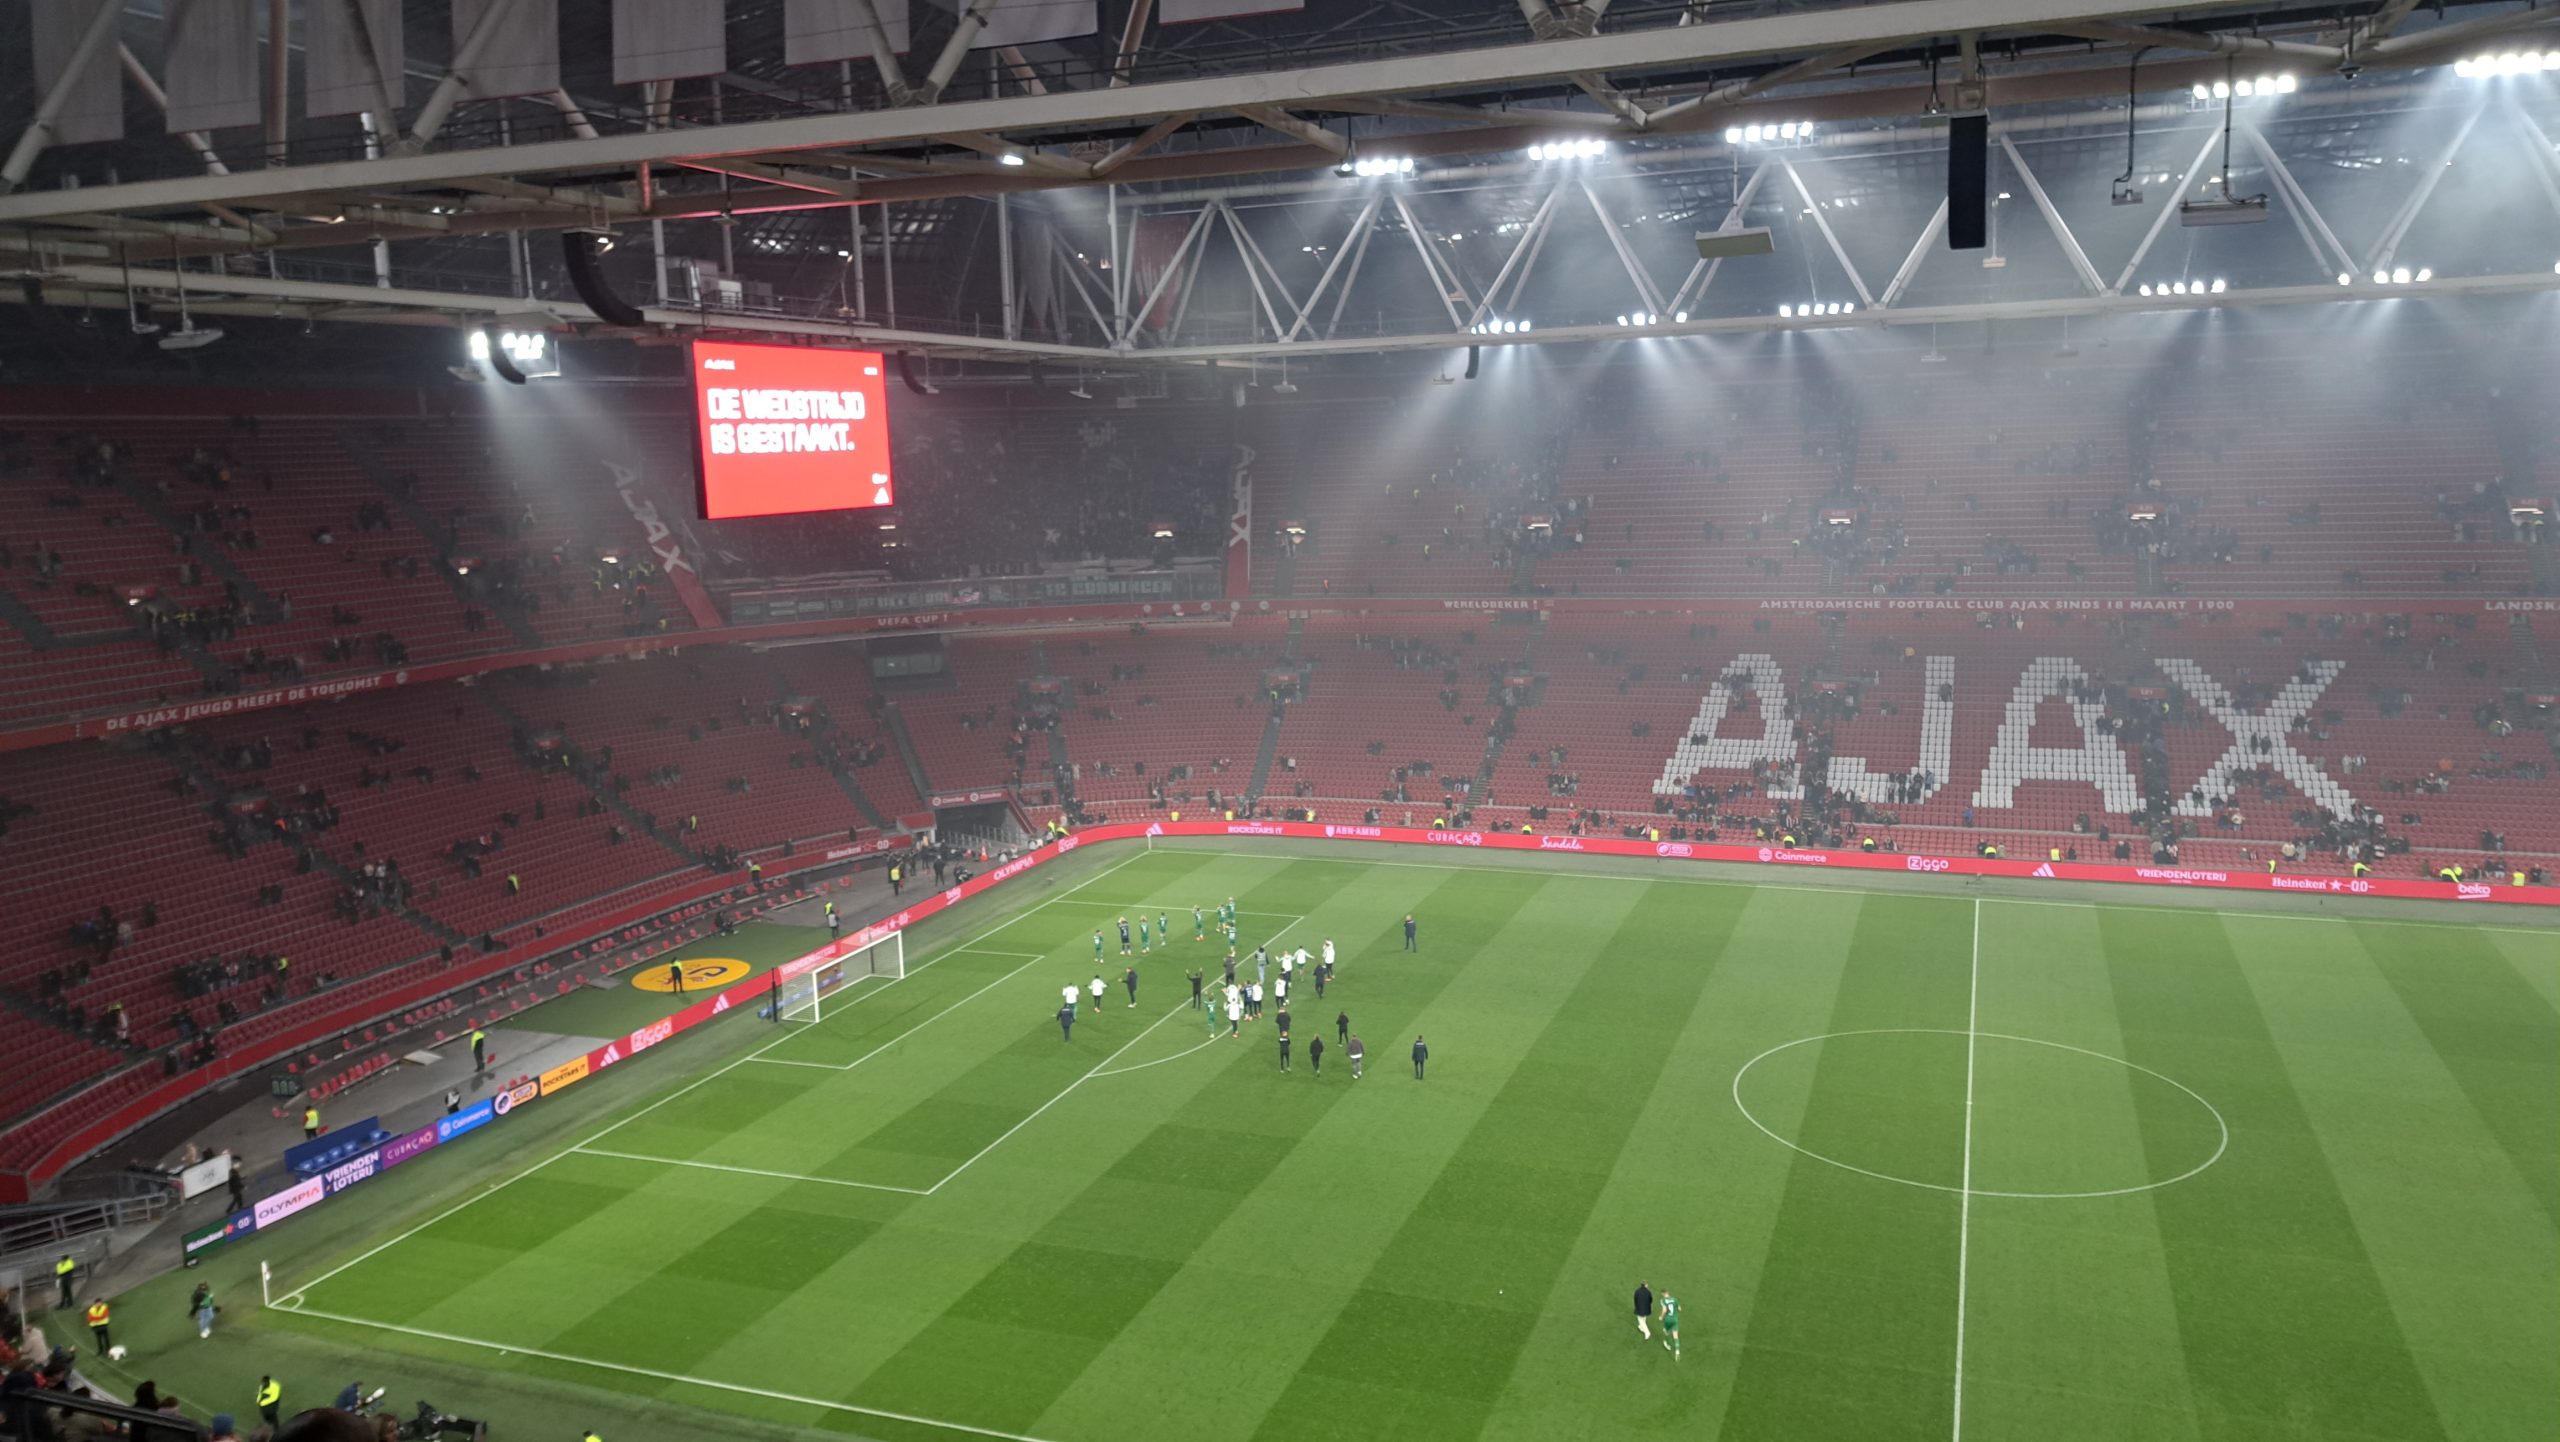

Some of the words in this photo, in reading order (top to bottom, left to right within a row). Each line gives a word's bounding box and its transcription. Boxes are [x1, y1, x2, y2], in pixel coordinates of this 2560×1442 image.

[707, 388, 741, 420] DE
[742, 389, 866, 420] WEDSTRIJD
[710, 423, 736, 454] IS
[737, 423, 855, 454] GESTAAKT.
[601, 459, 695, 574] AJAX
[1443, 600, 1529, 609] WERELDBEKER
[1760, 600, 1881, 609] AMSTERDAMSCHE
[1889, 600, 1961, 609] FOOTBALL
[1967, 600, 2004, 609] CLUB
[2010, 600, 2050, 611] AJAX
[2055, 600, 2100, 609] SINDS
[2107, 600, 2124, 609] 18
[2131, 600, 2186, 609] MAART
[2199, 600, 2235, 609] 1900
[878, 615, 909, 626] UEFA
[914, 614, 939, 624] CUP
[107, 717, 128, 731] DE
[135, 709, 178, 727] AJAX
[184, 700, 233, 720] JEUGD
[238, 692, 282, 709] HEEFT
[288, 688, 306, 701] DE
[311, 676, 382, 697] TOEKOMST
[1652, 653, 2358, 823] AJAX
[993, 855, 1034, 881] OLYMPIA
[1775, 852, 1827, 864] Coinmerce
[2136, 868, 2227, 882] VRIENDENLOTERIJ
[2272, 876, 2327, 890] Heineken
[2458, 883, 2491, 895] beko
[387, 1130, 433, 1160] CURAÇAO
[325, 1150, 379, 1184] VRIENDEN
[333, 1164, 374, 1193] LOTERIJ
[258, 1186, 321, 1220] OLYMPIA
